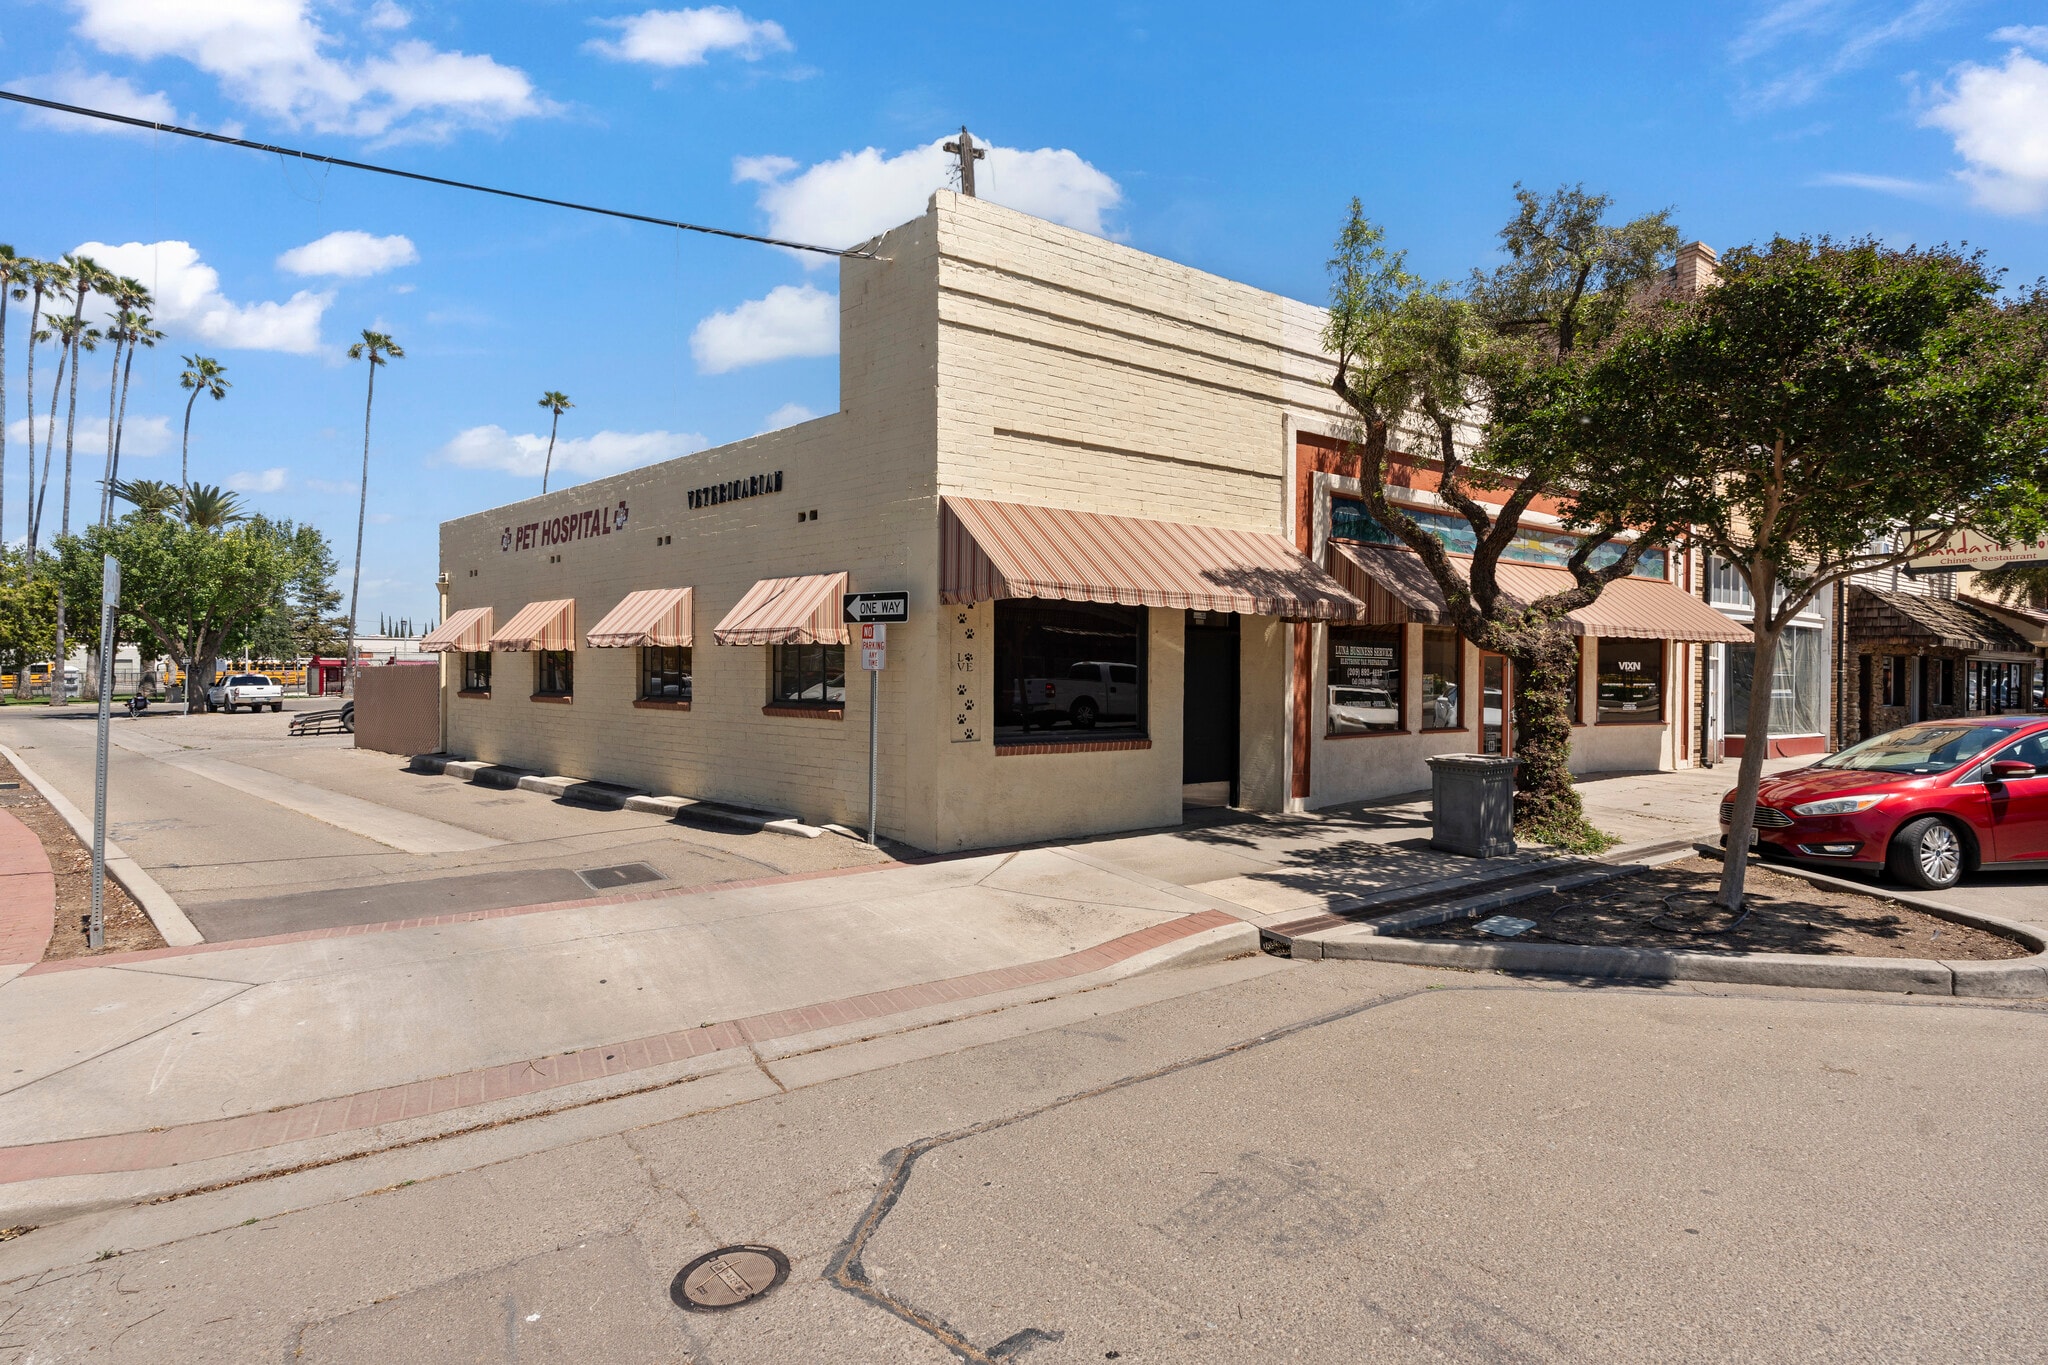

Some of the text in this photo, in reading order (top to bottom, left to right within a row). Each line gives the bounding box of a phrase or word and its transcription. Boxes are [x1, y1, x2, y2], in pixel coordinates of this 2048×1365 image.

[687, 470, 783, 510] VETERINARIAN
[515, 506, 611, 552] PET HOSPITAL
[1940, 552, 2038, 565] Chinese Restaurant
[860, 601, 901, 615] ONE WAY
[863, 626, 873, 637] NO
[863, 641, 885, 651] PARKING
[1335, 645, 1394, 657] LUNA BUSINESS SERVICE
[869, 651, 877, 659] ANY
[868, 659, 878, 667] TIME
[1618, 661, 1641, 671] VIXN
